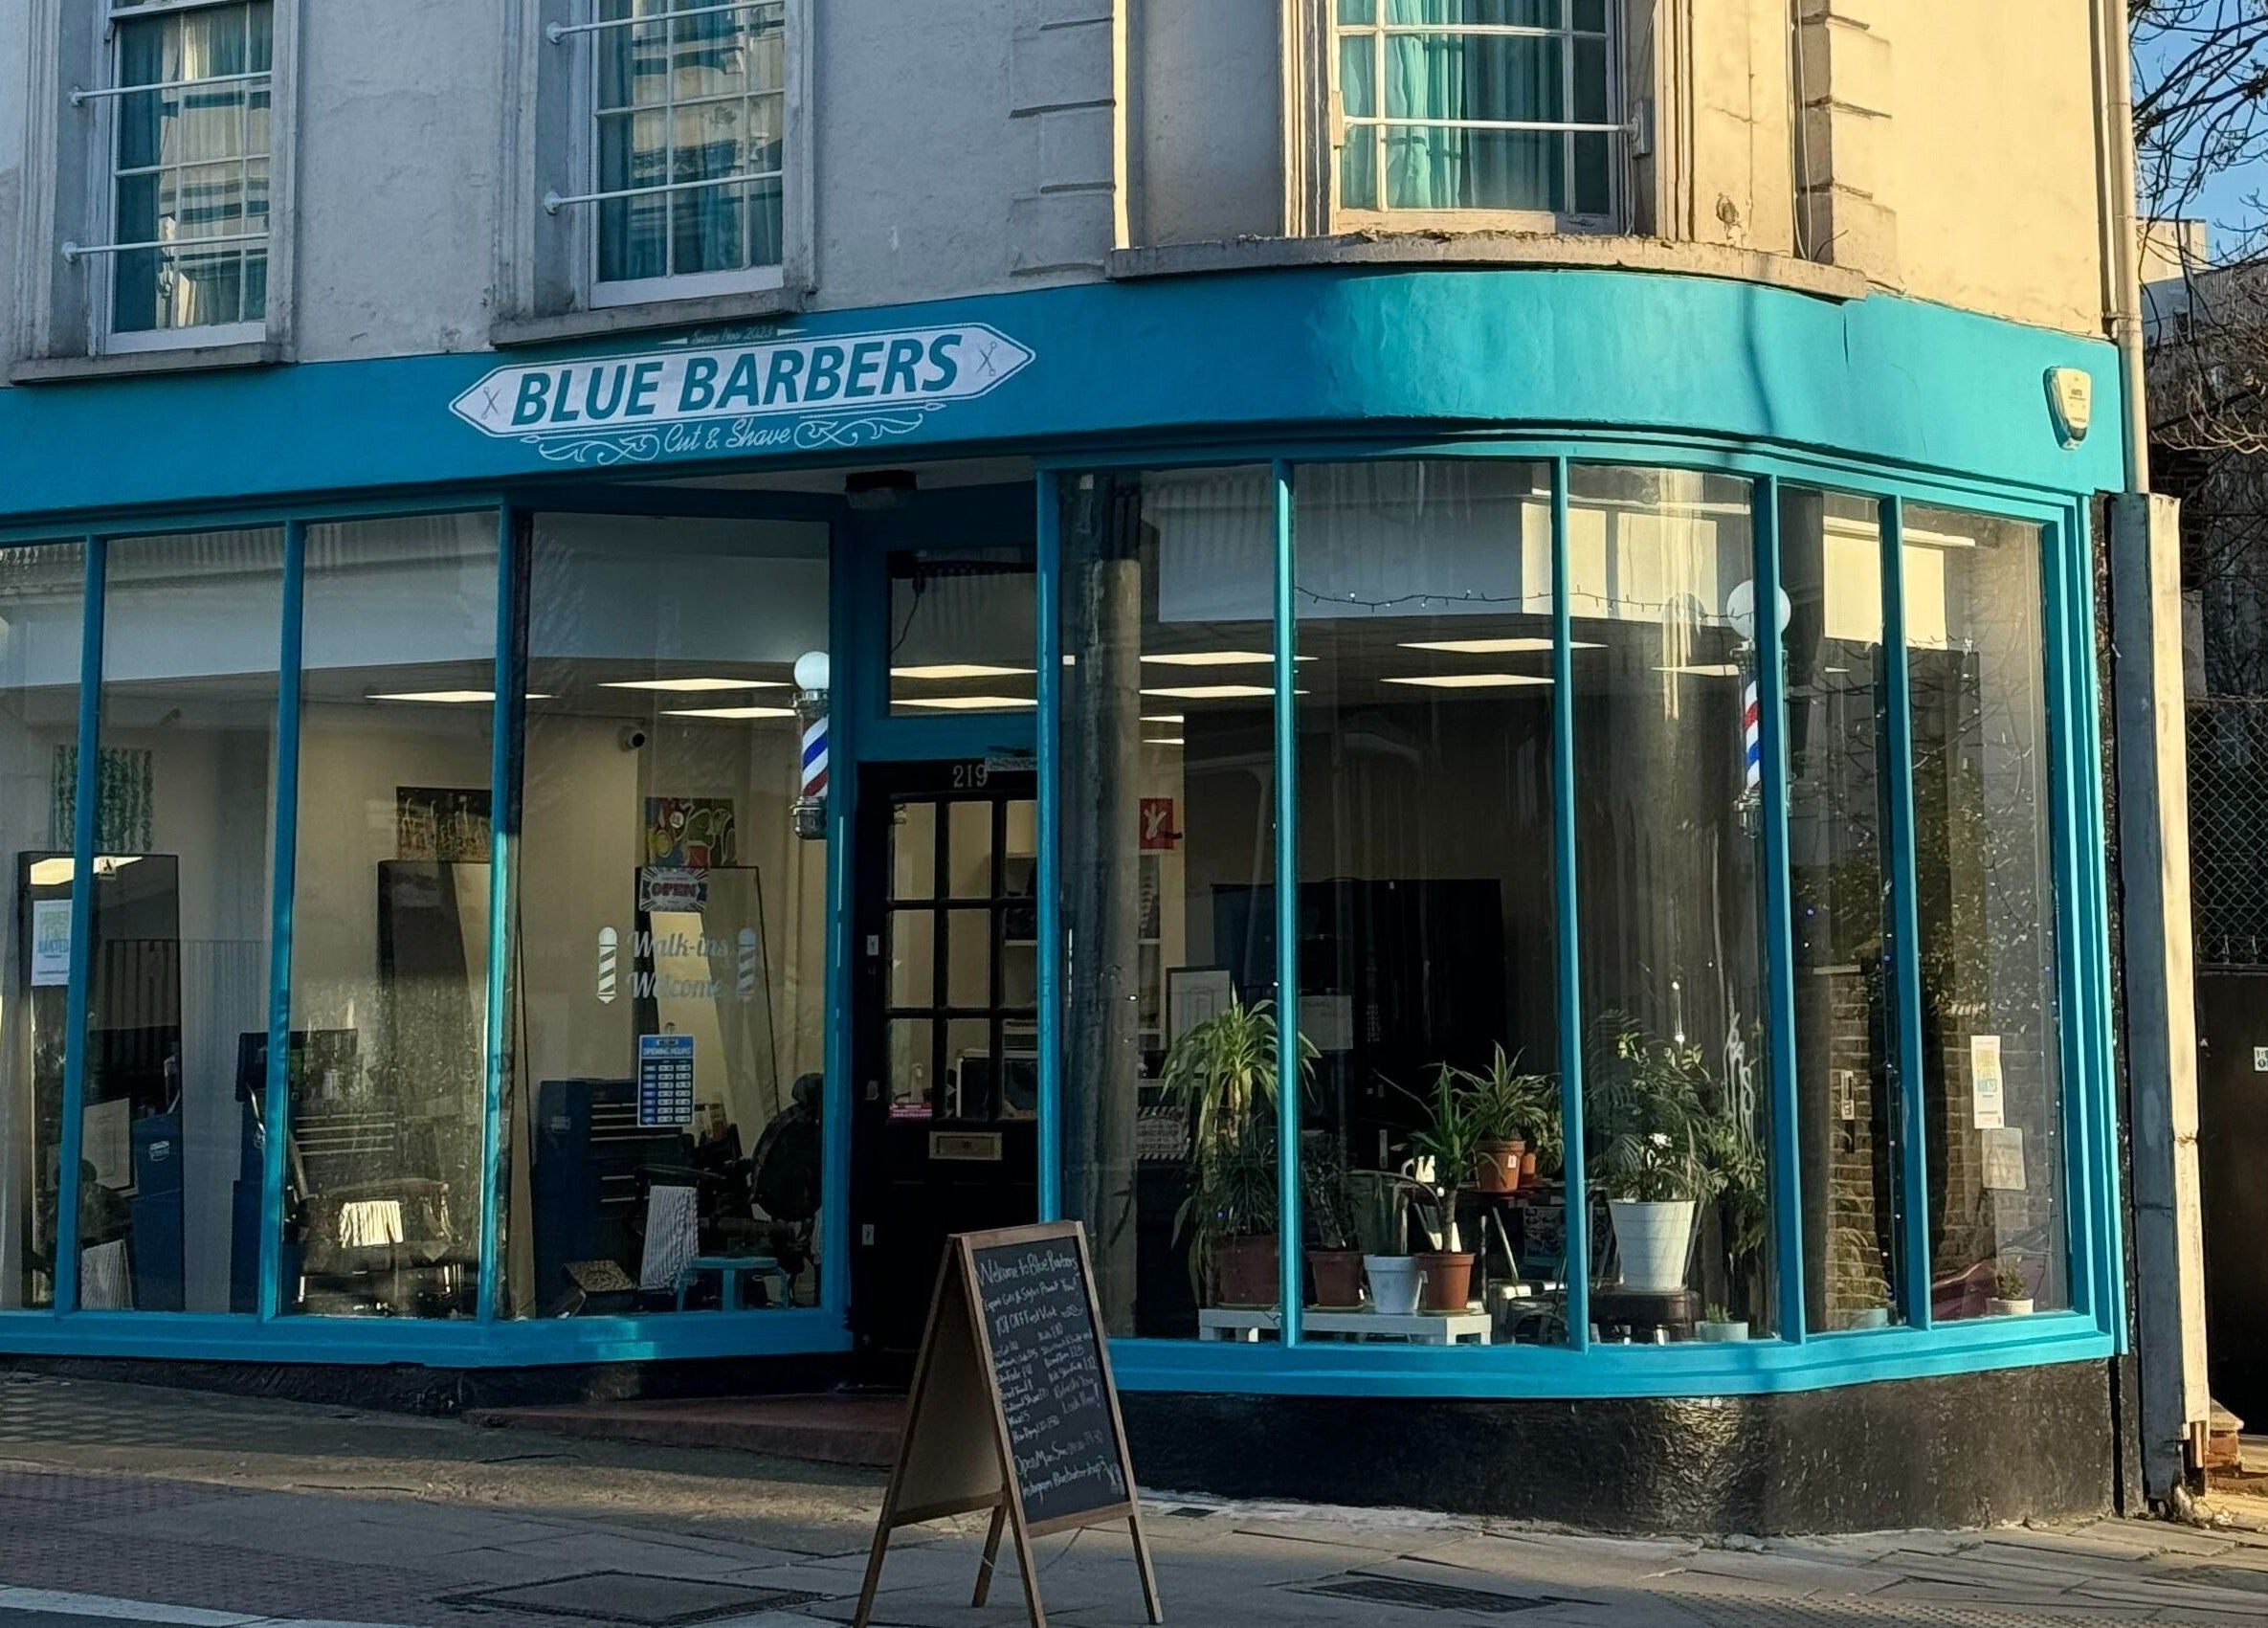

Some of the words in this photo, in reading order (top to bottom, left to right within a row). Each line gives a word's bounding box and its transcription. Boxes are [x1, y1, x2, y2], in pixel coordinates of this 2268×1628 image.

[510, 361, 664, 426] BLUE
[677, 333, 963, 413] BARBERS
[664, 423, 701, 453] Cut
[704, 427, 721, 450] &
[724, 415, 791, 449] Shave
[952, 764, 989, 789] 219
[651, 881, 698, 899] OPEN
[628, 930, 729, 958] Walk-ins
[627, 970, 723, 999] Welcome
[974, 1258, 1019, 1287] Welcome
[1027, 1252, 1050, 1276] Blue
